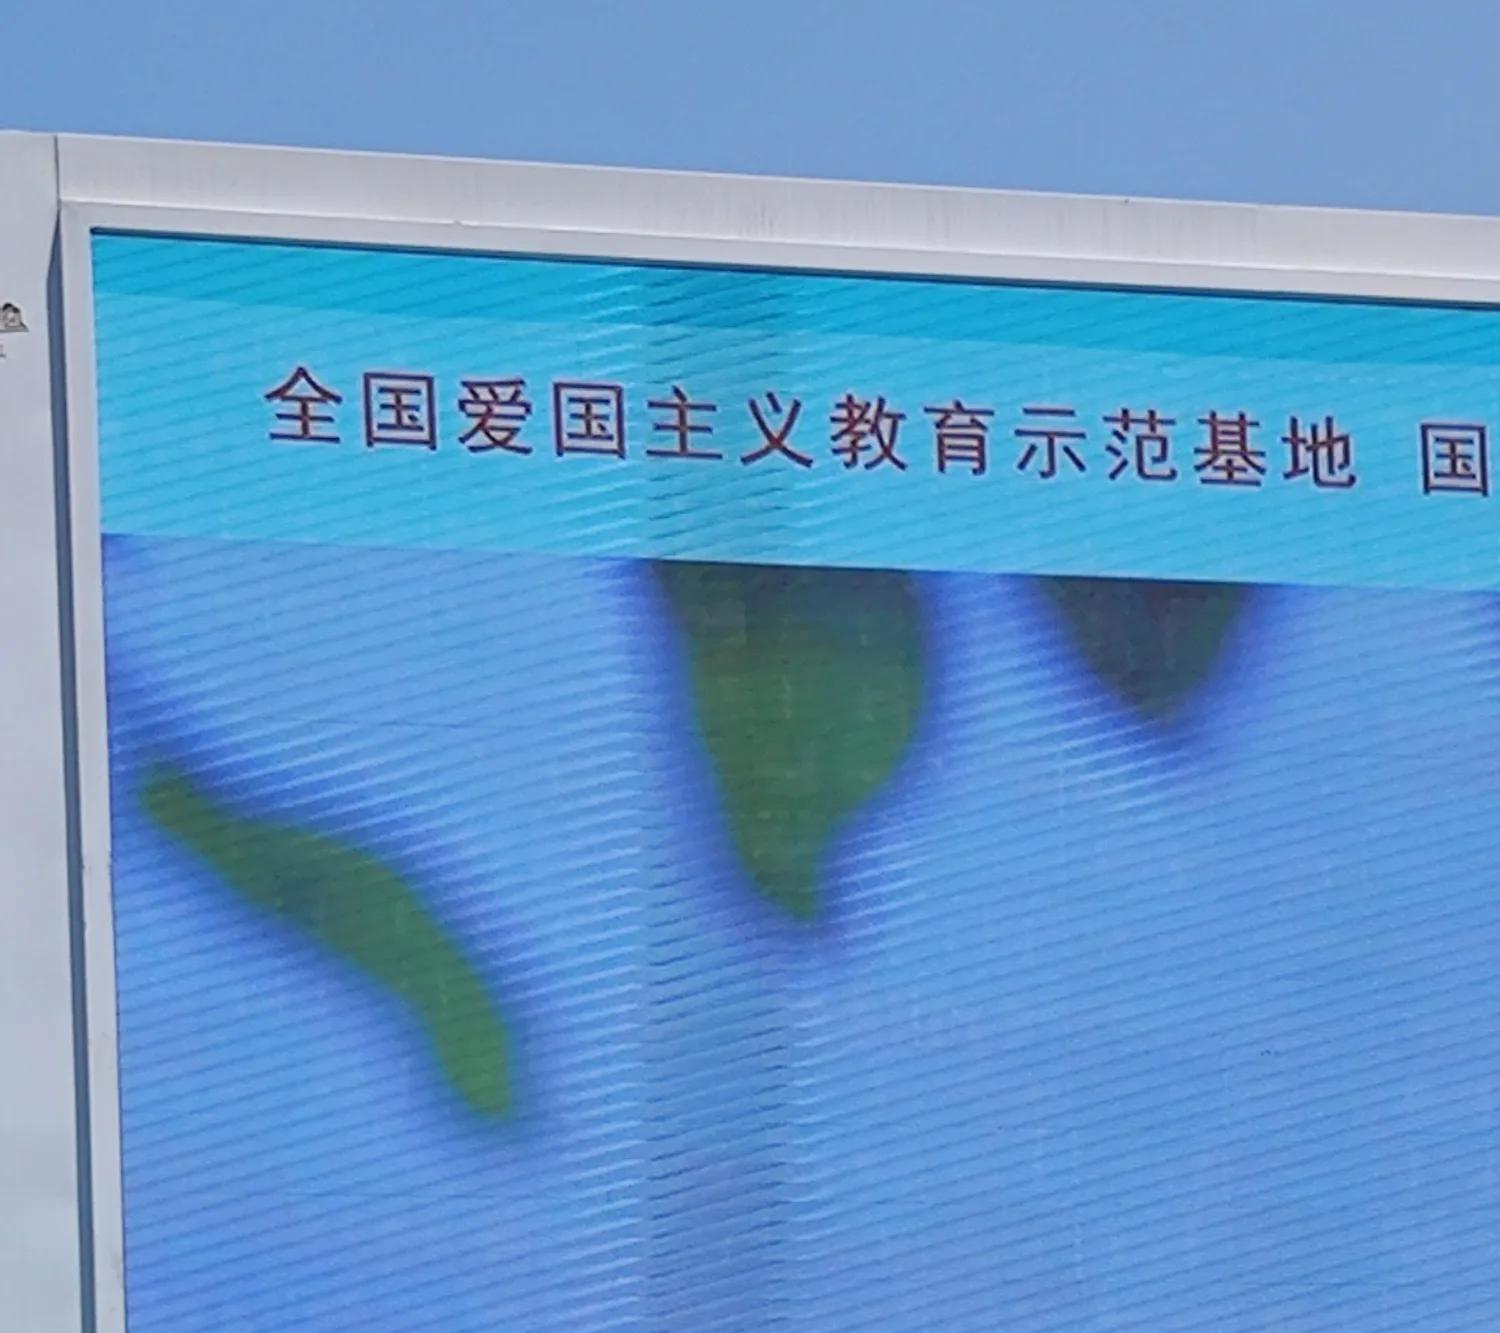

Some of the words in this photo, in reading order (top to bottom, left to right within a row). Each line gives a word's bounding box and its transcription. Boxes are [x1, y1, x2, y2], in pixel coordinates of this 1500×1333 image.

[265, 366, 1357, 489] 全国爱国主义教育示范基地
